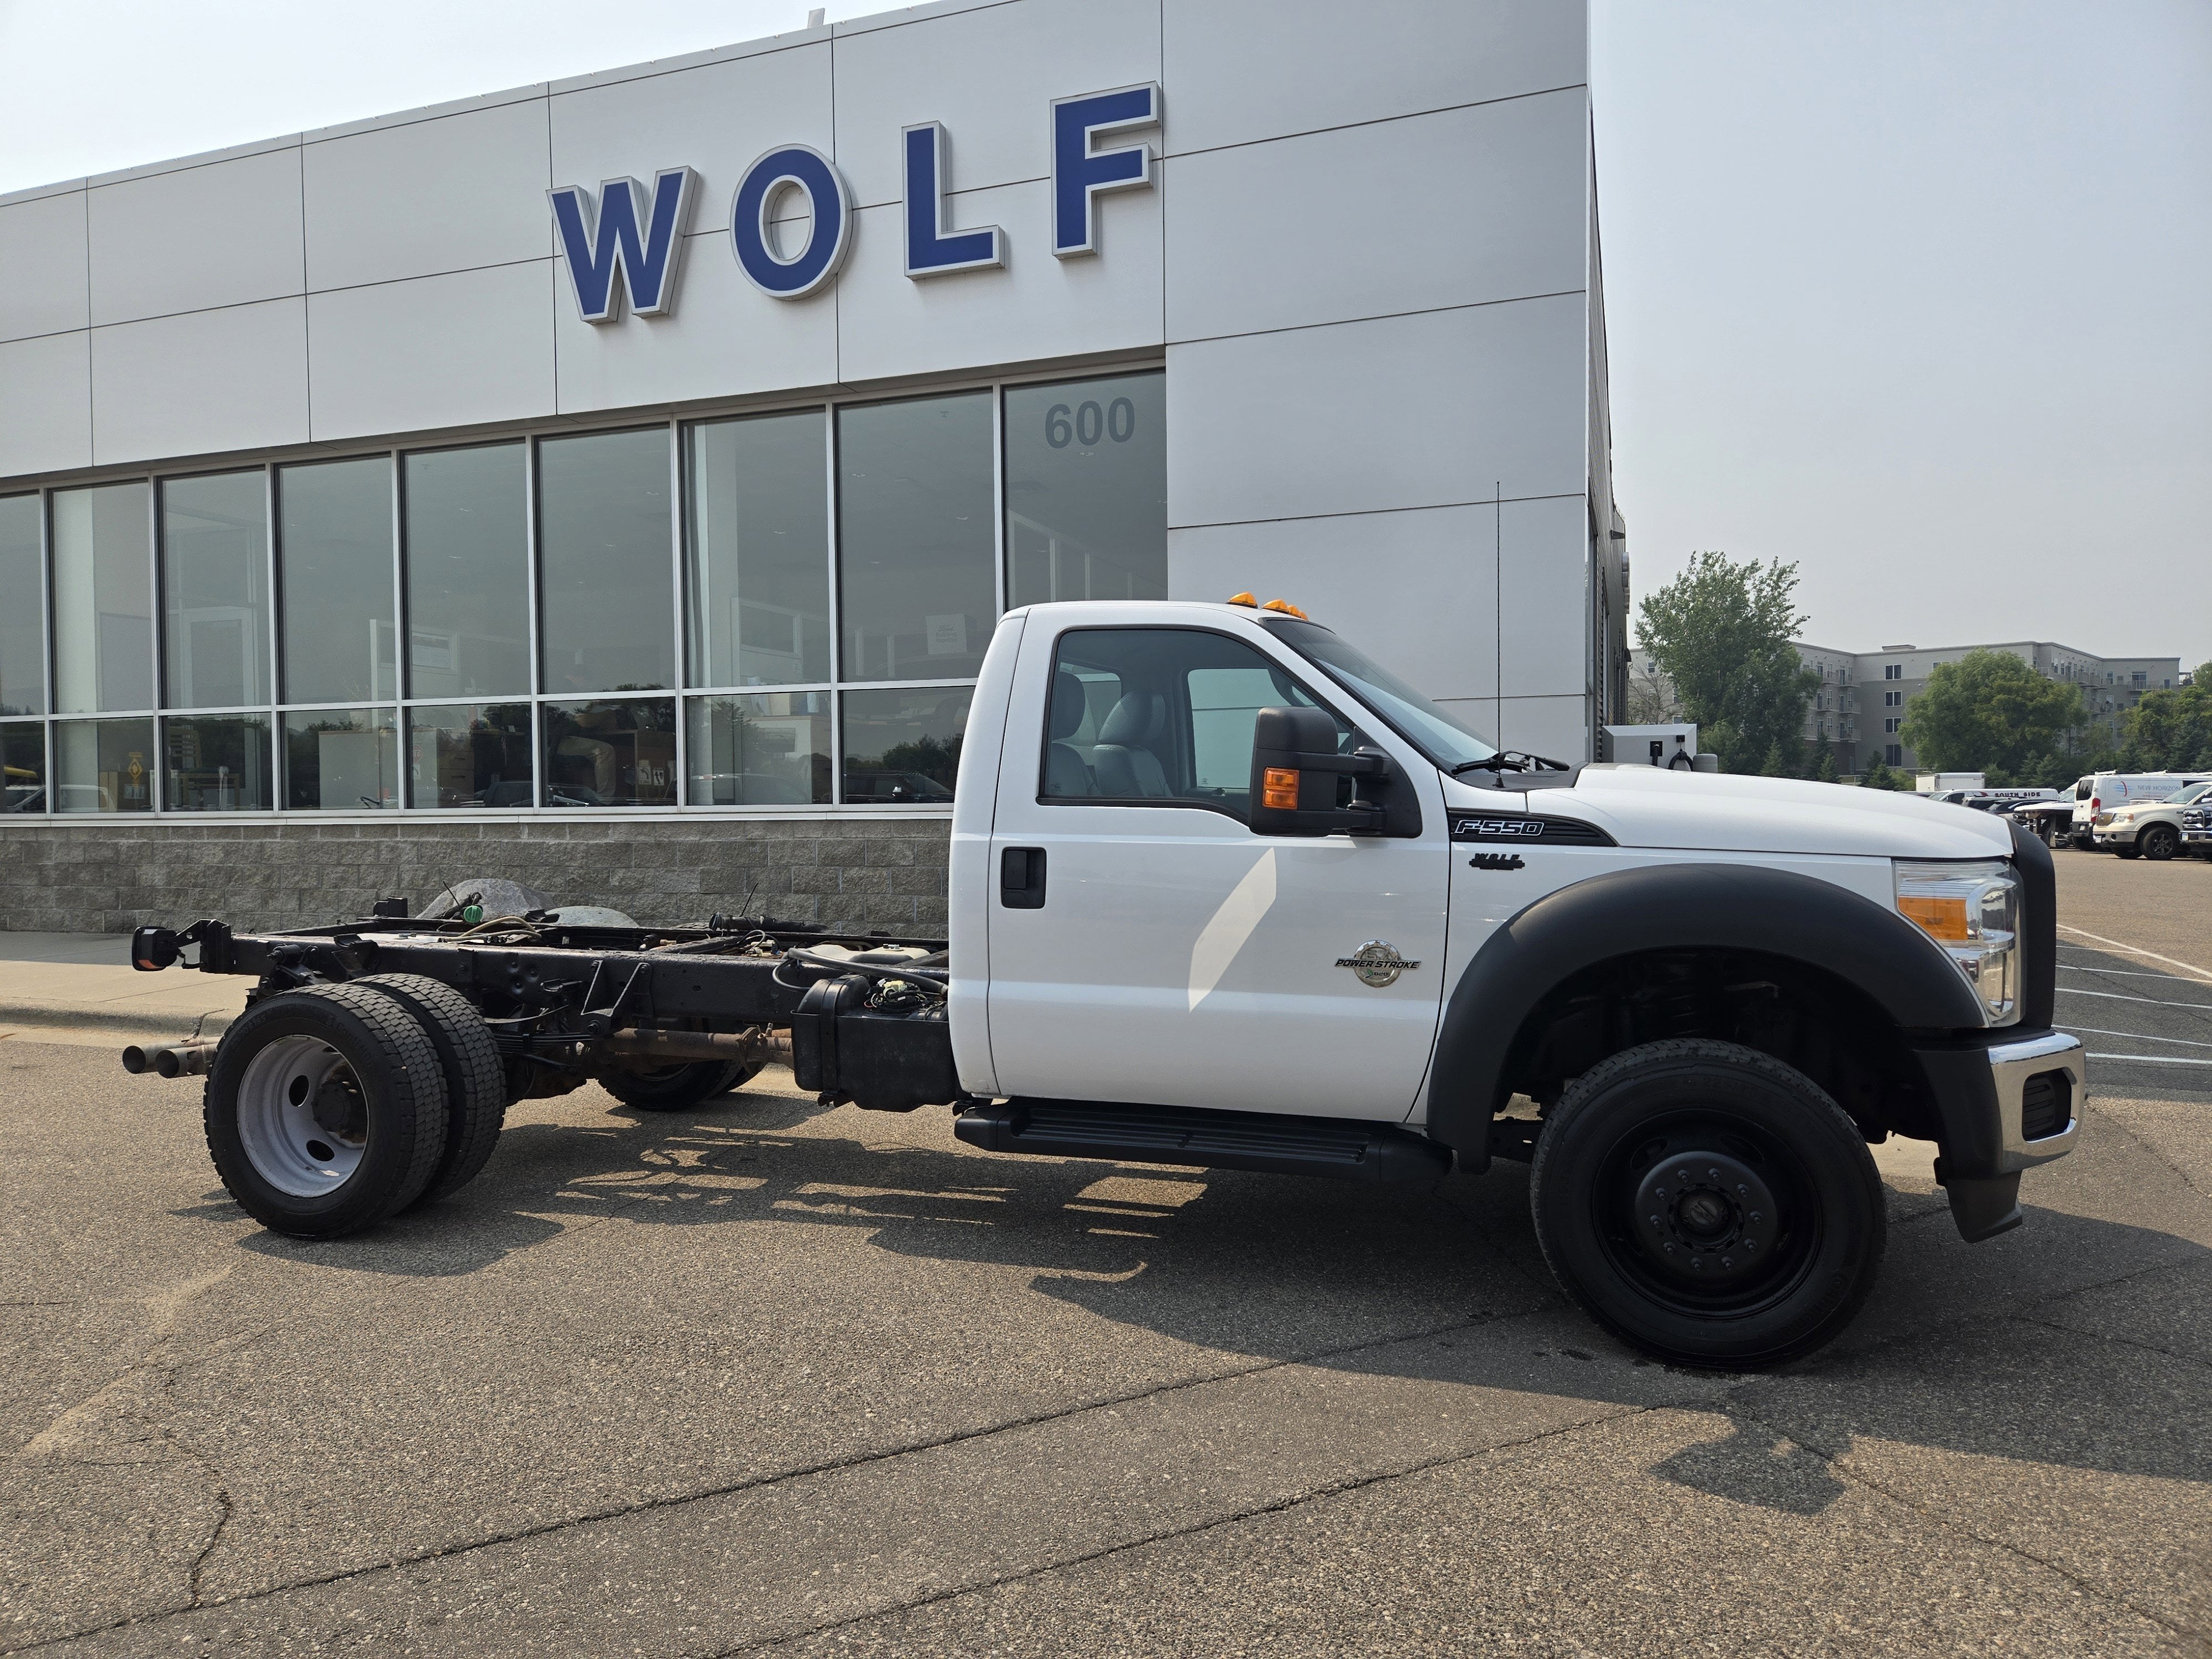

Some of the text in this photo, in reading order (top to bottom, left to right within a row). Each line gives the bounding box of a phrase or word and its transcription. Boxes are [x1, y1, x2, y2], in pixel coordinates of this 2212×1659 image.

[545, 81, 1162, 325] WOLF
[1045, 397, 1135, 448] 600
[1454, 820, 1545, 836] F-550
[1335, 958, 1422, 969] POWER STROKE
